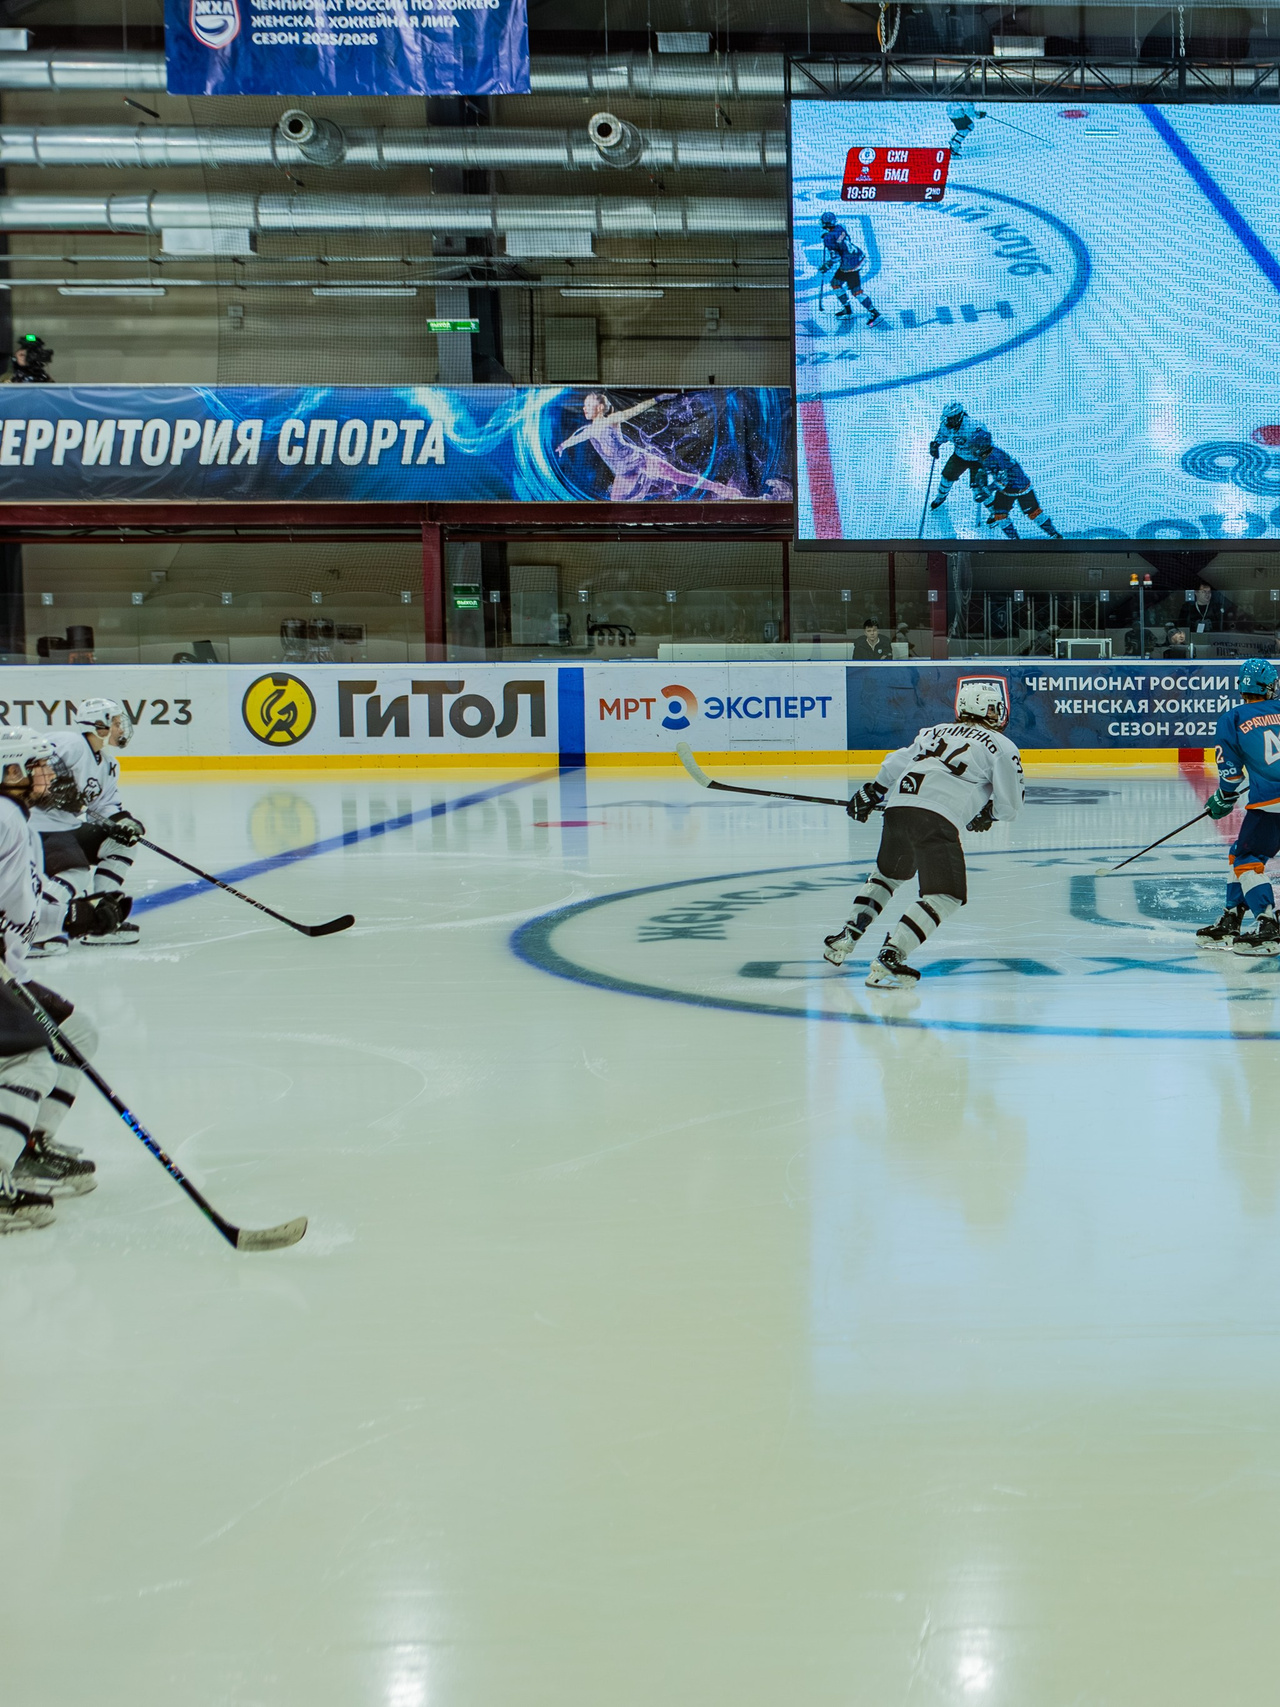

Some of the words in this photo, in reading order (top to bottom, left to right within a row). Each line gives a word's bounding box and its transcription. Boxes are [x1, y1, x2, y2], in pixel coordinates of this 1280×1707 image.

[196, 1, 234, 15] ЖХЛ
[251, 0, 342, 11] ЧЕМПИОНАТ
[345, 0, 408, 11] РОССИИ
[411, 0, 433, 10] ПО
[436, 0, 500, 10] ХОККЕЮ
[251, 15, 325, 28] ЖЕНСКАЯ
[328, 12, 420, 28] ХОККЕЙНАЯ
[421, 15, 460, 28] ЛИГА
[251, 32, 300, 45] СЕЗОН
[302, 32, 379, 46] 2025/2026
[887, 150, 909, 163] СХН
[936, 150, 945, 163] 0
[884, 168, 910, 182] БМД
[933, 169, 942, 182] 0
[846, 187, 877, 199] 19:56
[0, 419, 263, 465] ЕРРИТОРИЯ
[277, 419, 446, 465] СПОРТА
[1025, 676, 1145, 691] ЧЕМПИОНАТ
[1150, 676, 1230, 691] РОССИИ
[600, 698, 656, 720] МРТ
[704, 696, 832, 719] ЭКСПЕРТ
[1054, 699, 1149, 714] ЖЕНСКАЯ
[1108, 722, 1170, 736] СЕЗОН
